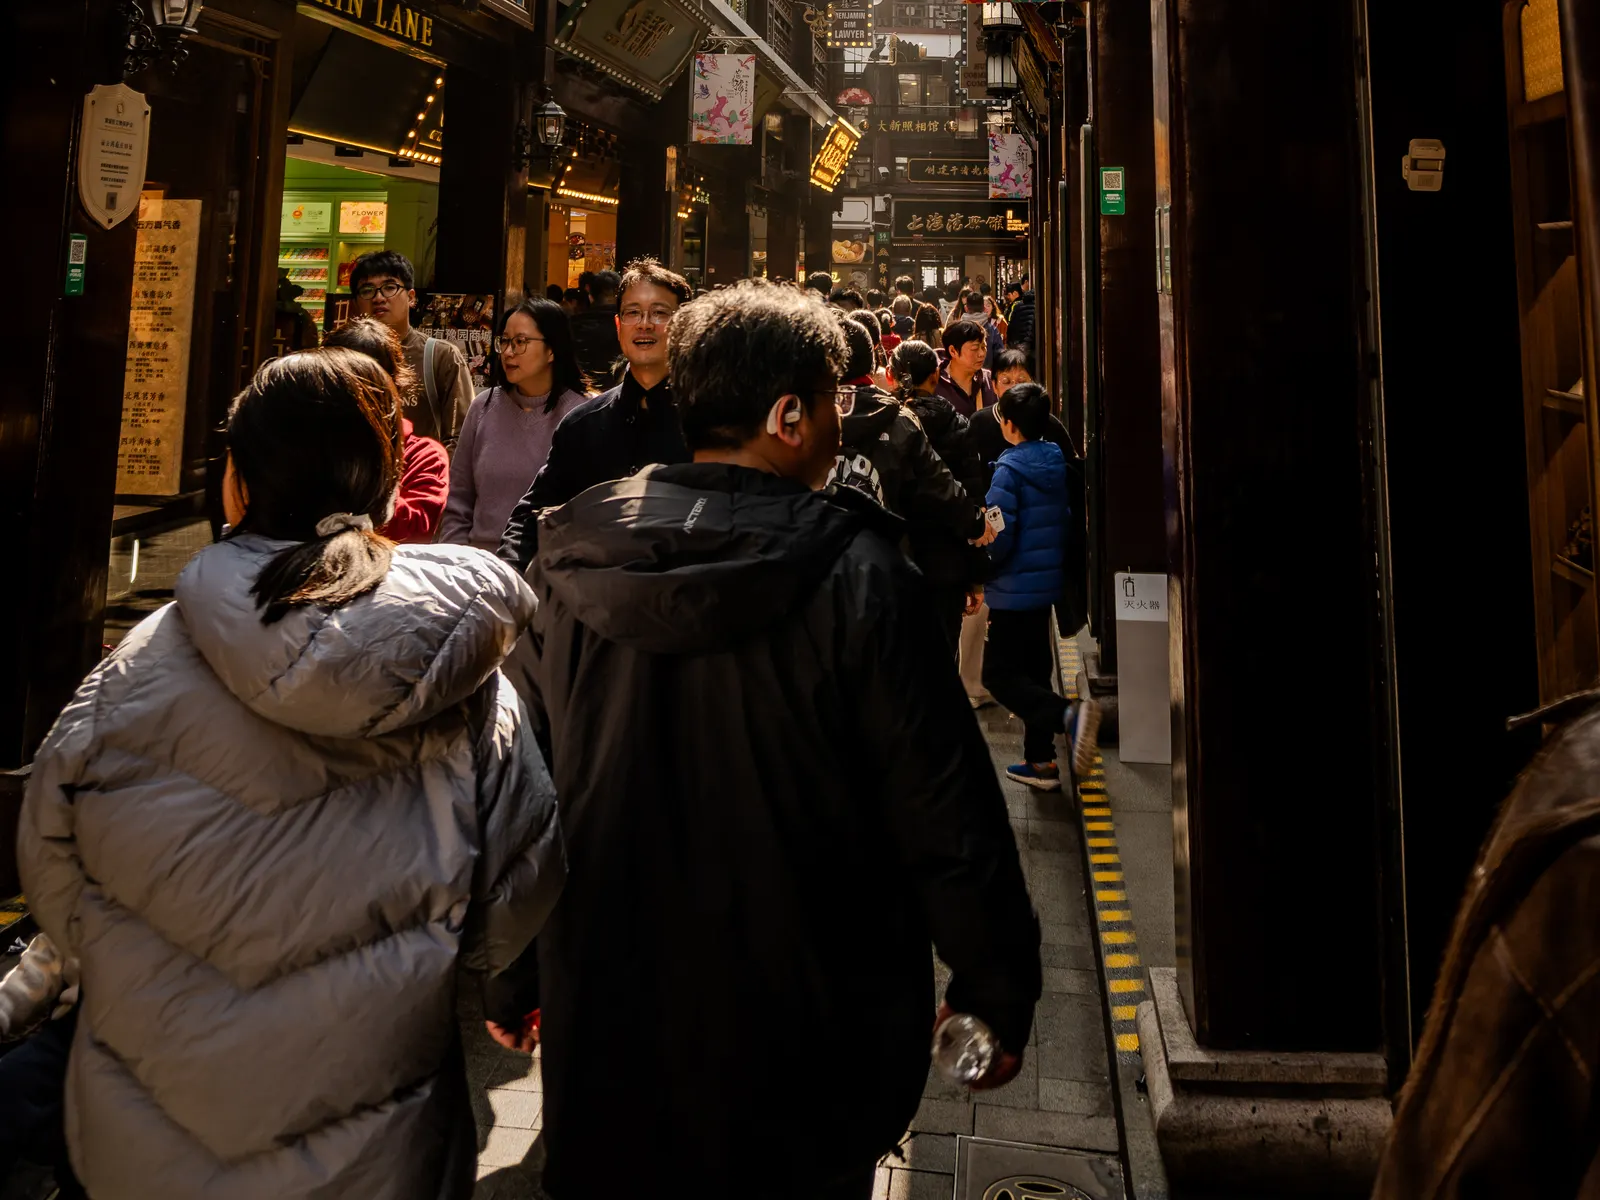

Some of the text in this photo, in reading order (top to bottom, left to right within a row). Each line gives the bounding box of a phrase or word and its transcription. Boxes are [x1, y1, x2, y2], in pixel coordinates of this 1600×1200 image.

[834, 30, 865, 39] LAWYER
[1124, 600, 1160, 610] 灭火器
